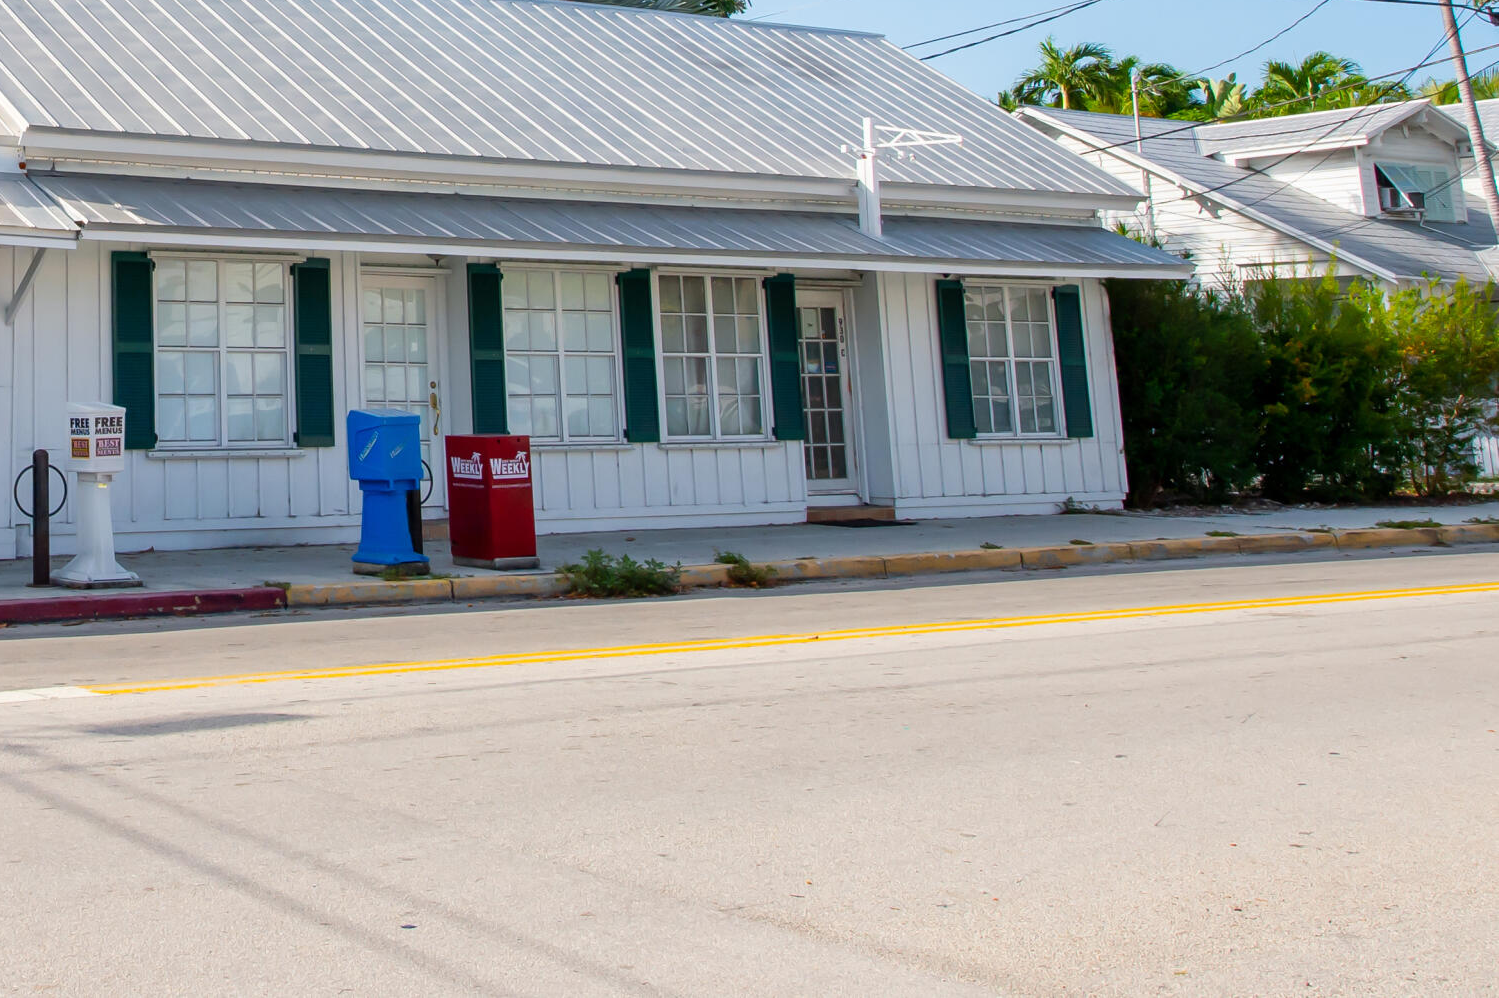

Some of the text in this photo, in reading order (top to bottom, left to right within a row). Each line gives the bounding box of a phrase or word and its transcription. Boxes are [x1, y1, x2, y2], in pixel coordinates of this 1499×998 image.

[70, 418, 90, 428] FREE
[95, 417, 123, 427] FREE
[97, 439, 120, 448] BEST
